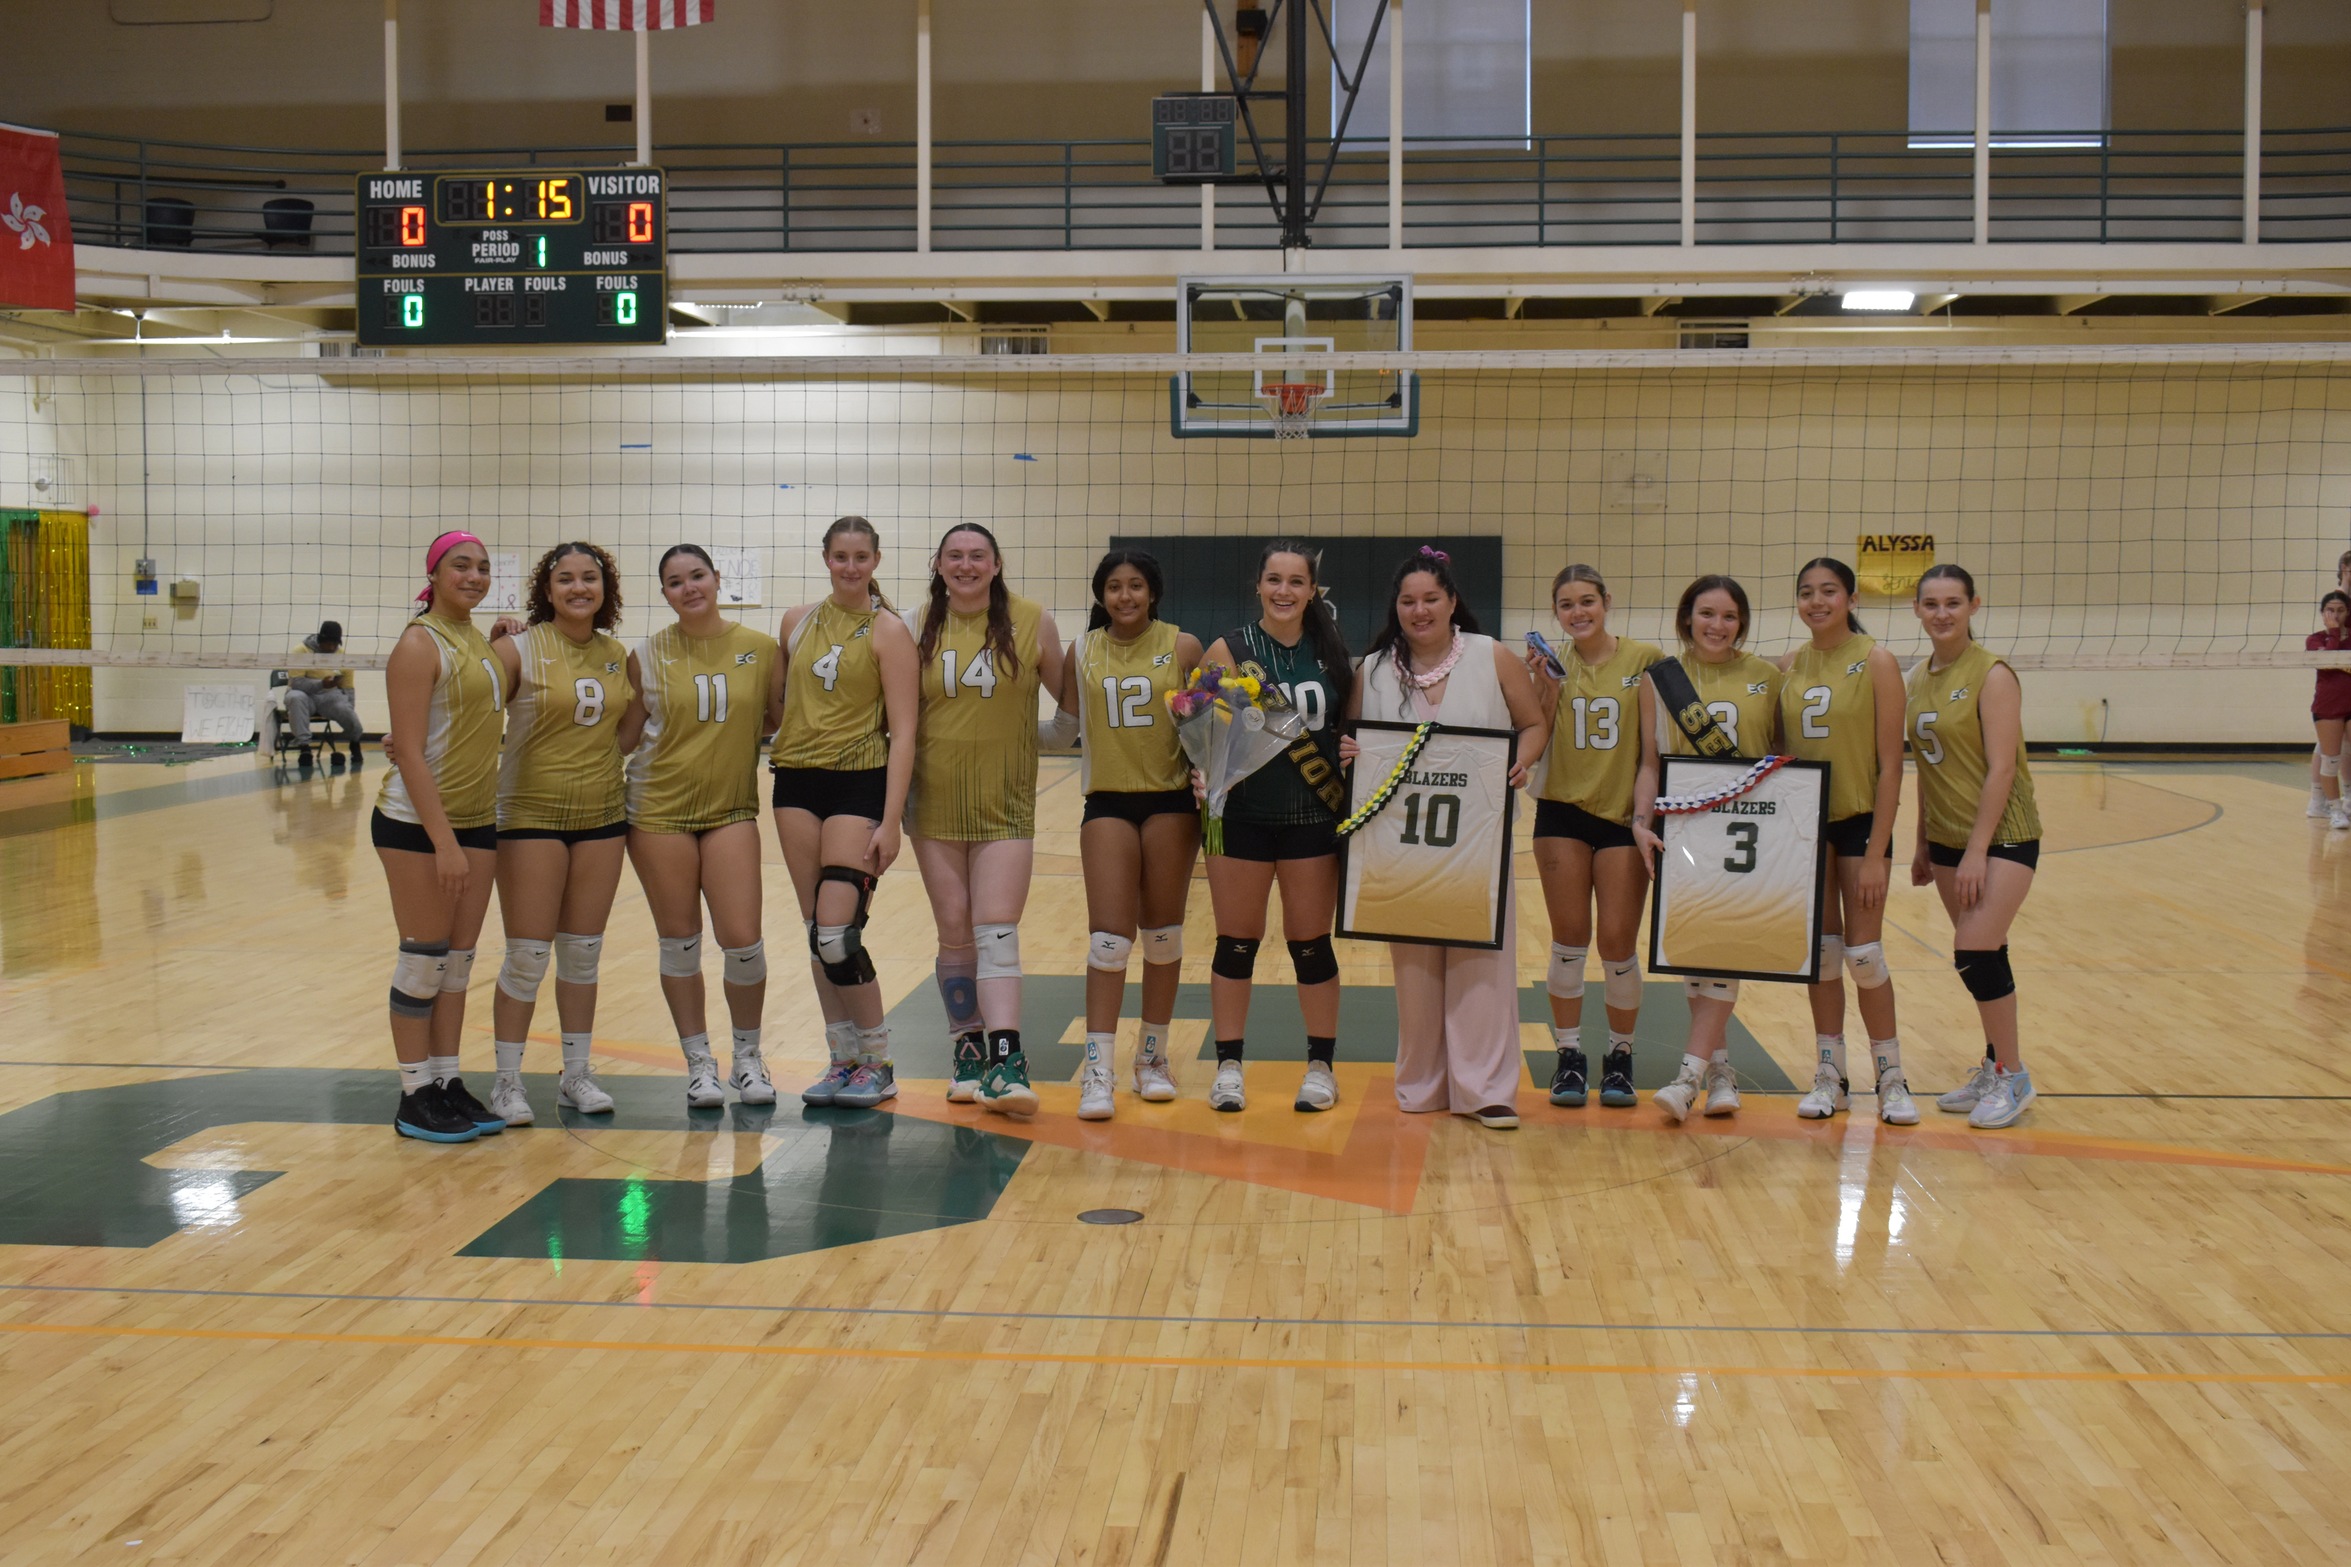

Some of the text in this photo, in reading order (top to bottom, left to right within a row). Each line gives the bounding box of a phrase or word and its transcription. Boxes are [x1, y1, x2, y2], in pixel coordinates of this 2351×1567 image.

[370, 179, 422, 199] HOME
[588, 175, 660, 195] VISITOR
[487, 179, 571, 220] 1:15
[402, 207, 425, 246] 0
[629, 203, 653, 242] 0
[482, 230, 508, 241] POSS
[392, 254, 436, 268] BONUS
[472, 243, 520, 257] PERIOD
[538, 236, 546, 267] 1
[584, 251, 628, 266] BONUS
[383, 278, 425, 293] FOULS
[465, 276, 567, 292] PLAYER FOULS
[596, 275, 638, 290] FOULS
[404, 295, 423, 327] 0
[617, 292, 636, 325] 0
[1862, 535, 1934, 552] ALYSSA
[734, 652, 758, 666] EC
[811, 644, 844, 692] 4
[1153, 653, 1172, 667] EC
[1846, 660, 1866, 675] EC
[481, 657, 501, 712] 1
[941, 648, 997, 699] 14
[693, 673, 728, 723] 11
[1747, 682, 1767, 696] EC
[1950, 686, 1968, 702] EC
[573, 677, 605, 727] 8
[1102, 676, 1154, 729] 12
[1801, 685, 1832, 739] 2
[1571, 697, 1620, 750] 13
[1916, 711, 1945, 765] 5
[1404, 770, 1468, 787] BLAZERS
[1400, 793, 1461, 847] 10
[1711, 801, 1776, 815] BLAZERS
[1724, 822, 1759, 873] 3
